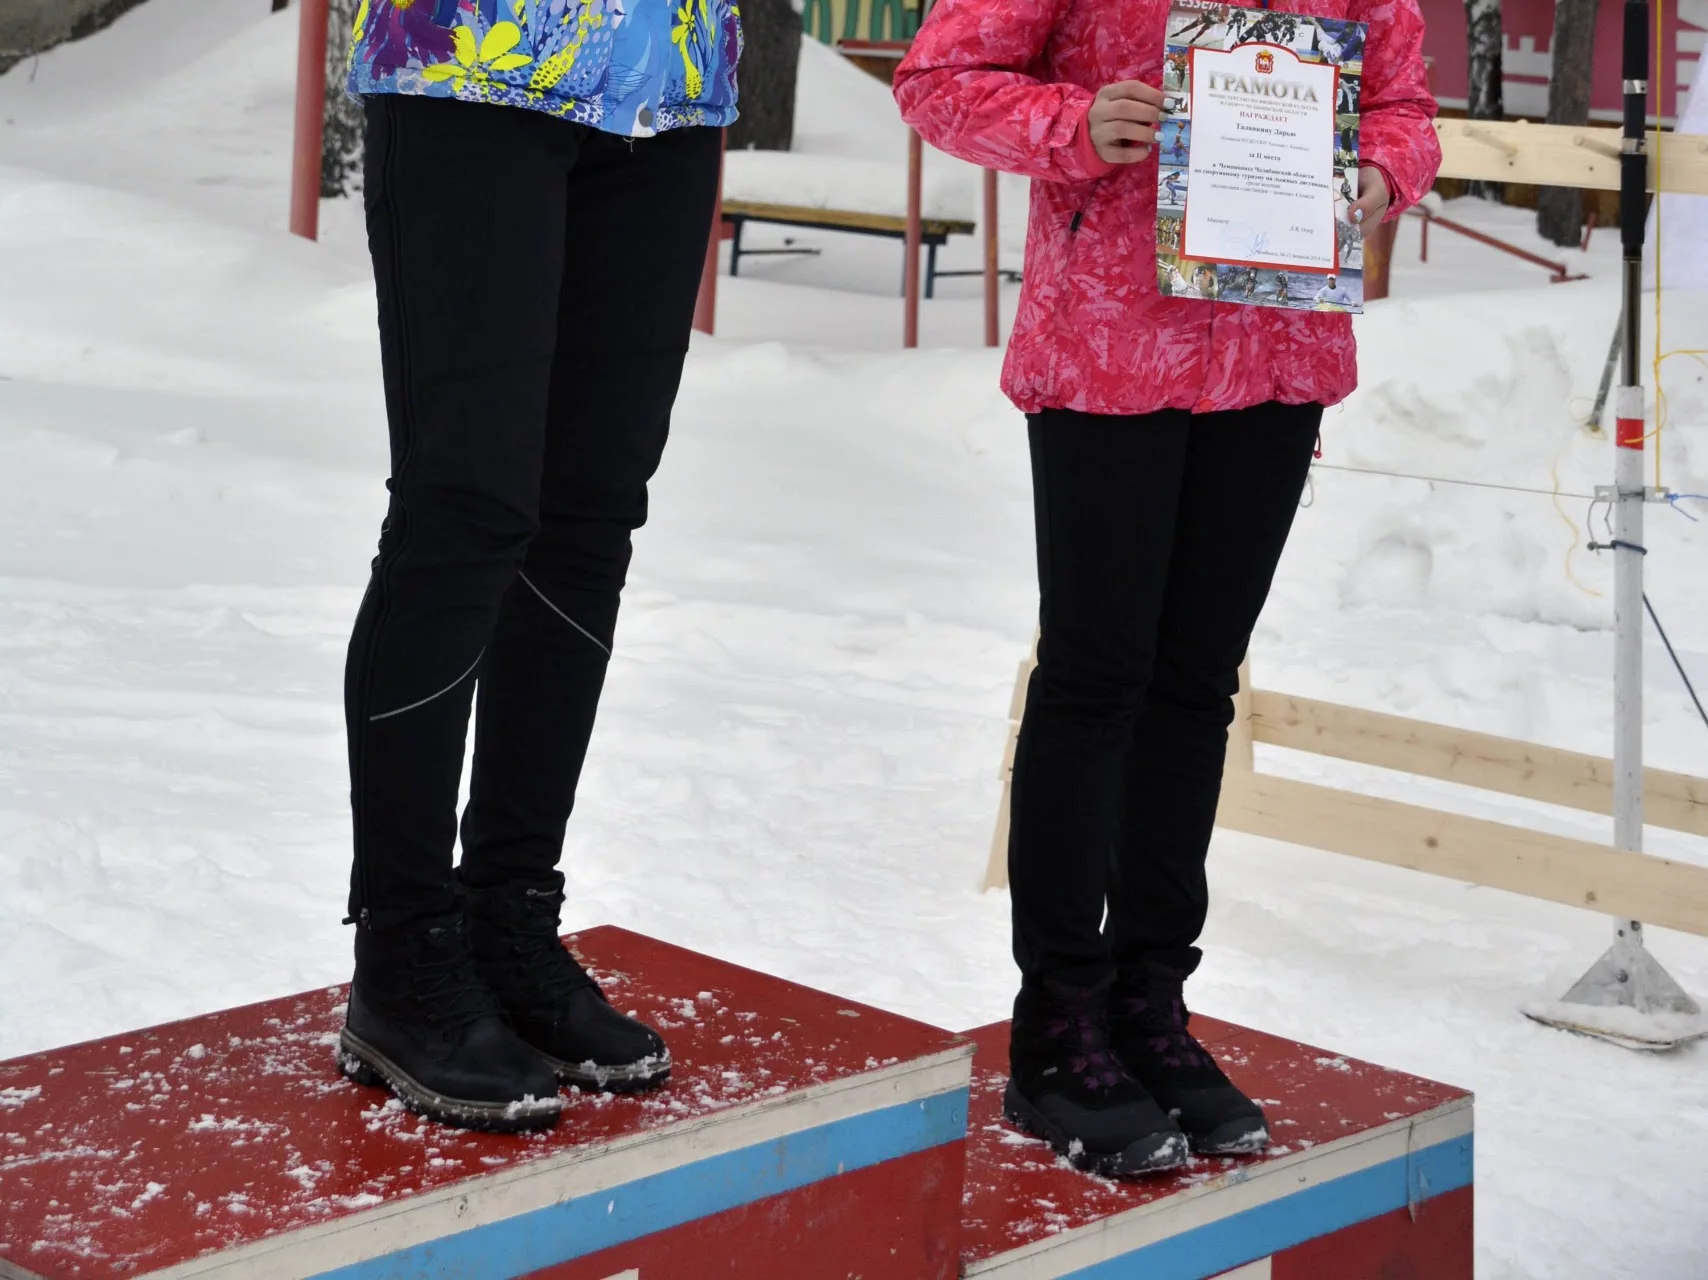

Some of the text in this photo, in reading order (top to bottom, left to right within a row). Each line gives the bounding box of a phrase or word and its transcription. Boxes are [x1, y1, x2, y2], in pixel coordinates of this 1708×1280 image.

[1208, 70, 1319, 103] ГРАМОТА
[1239, 111, 1289, 123] НАГРАЖДАЕТ
[1274, 128, 1297, 138] Дарью
[1202, 169, 1240, 179] спортивному
[1242, 174, 1265, 182] туризму
[1273, 177, 1298, 185] лыжных
[1218, 162, 1254, 172] Чемпионате
[1254, 166, 1292, 177] Челябинской
[1292, 171, 1315, 180] области
[1206, 216, 1230, 225] Министр
